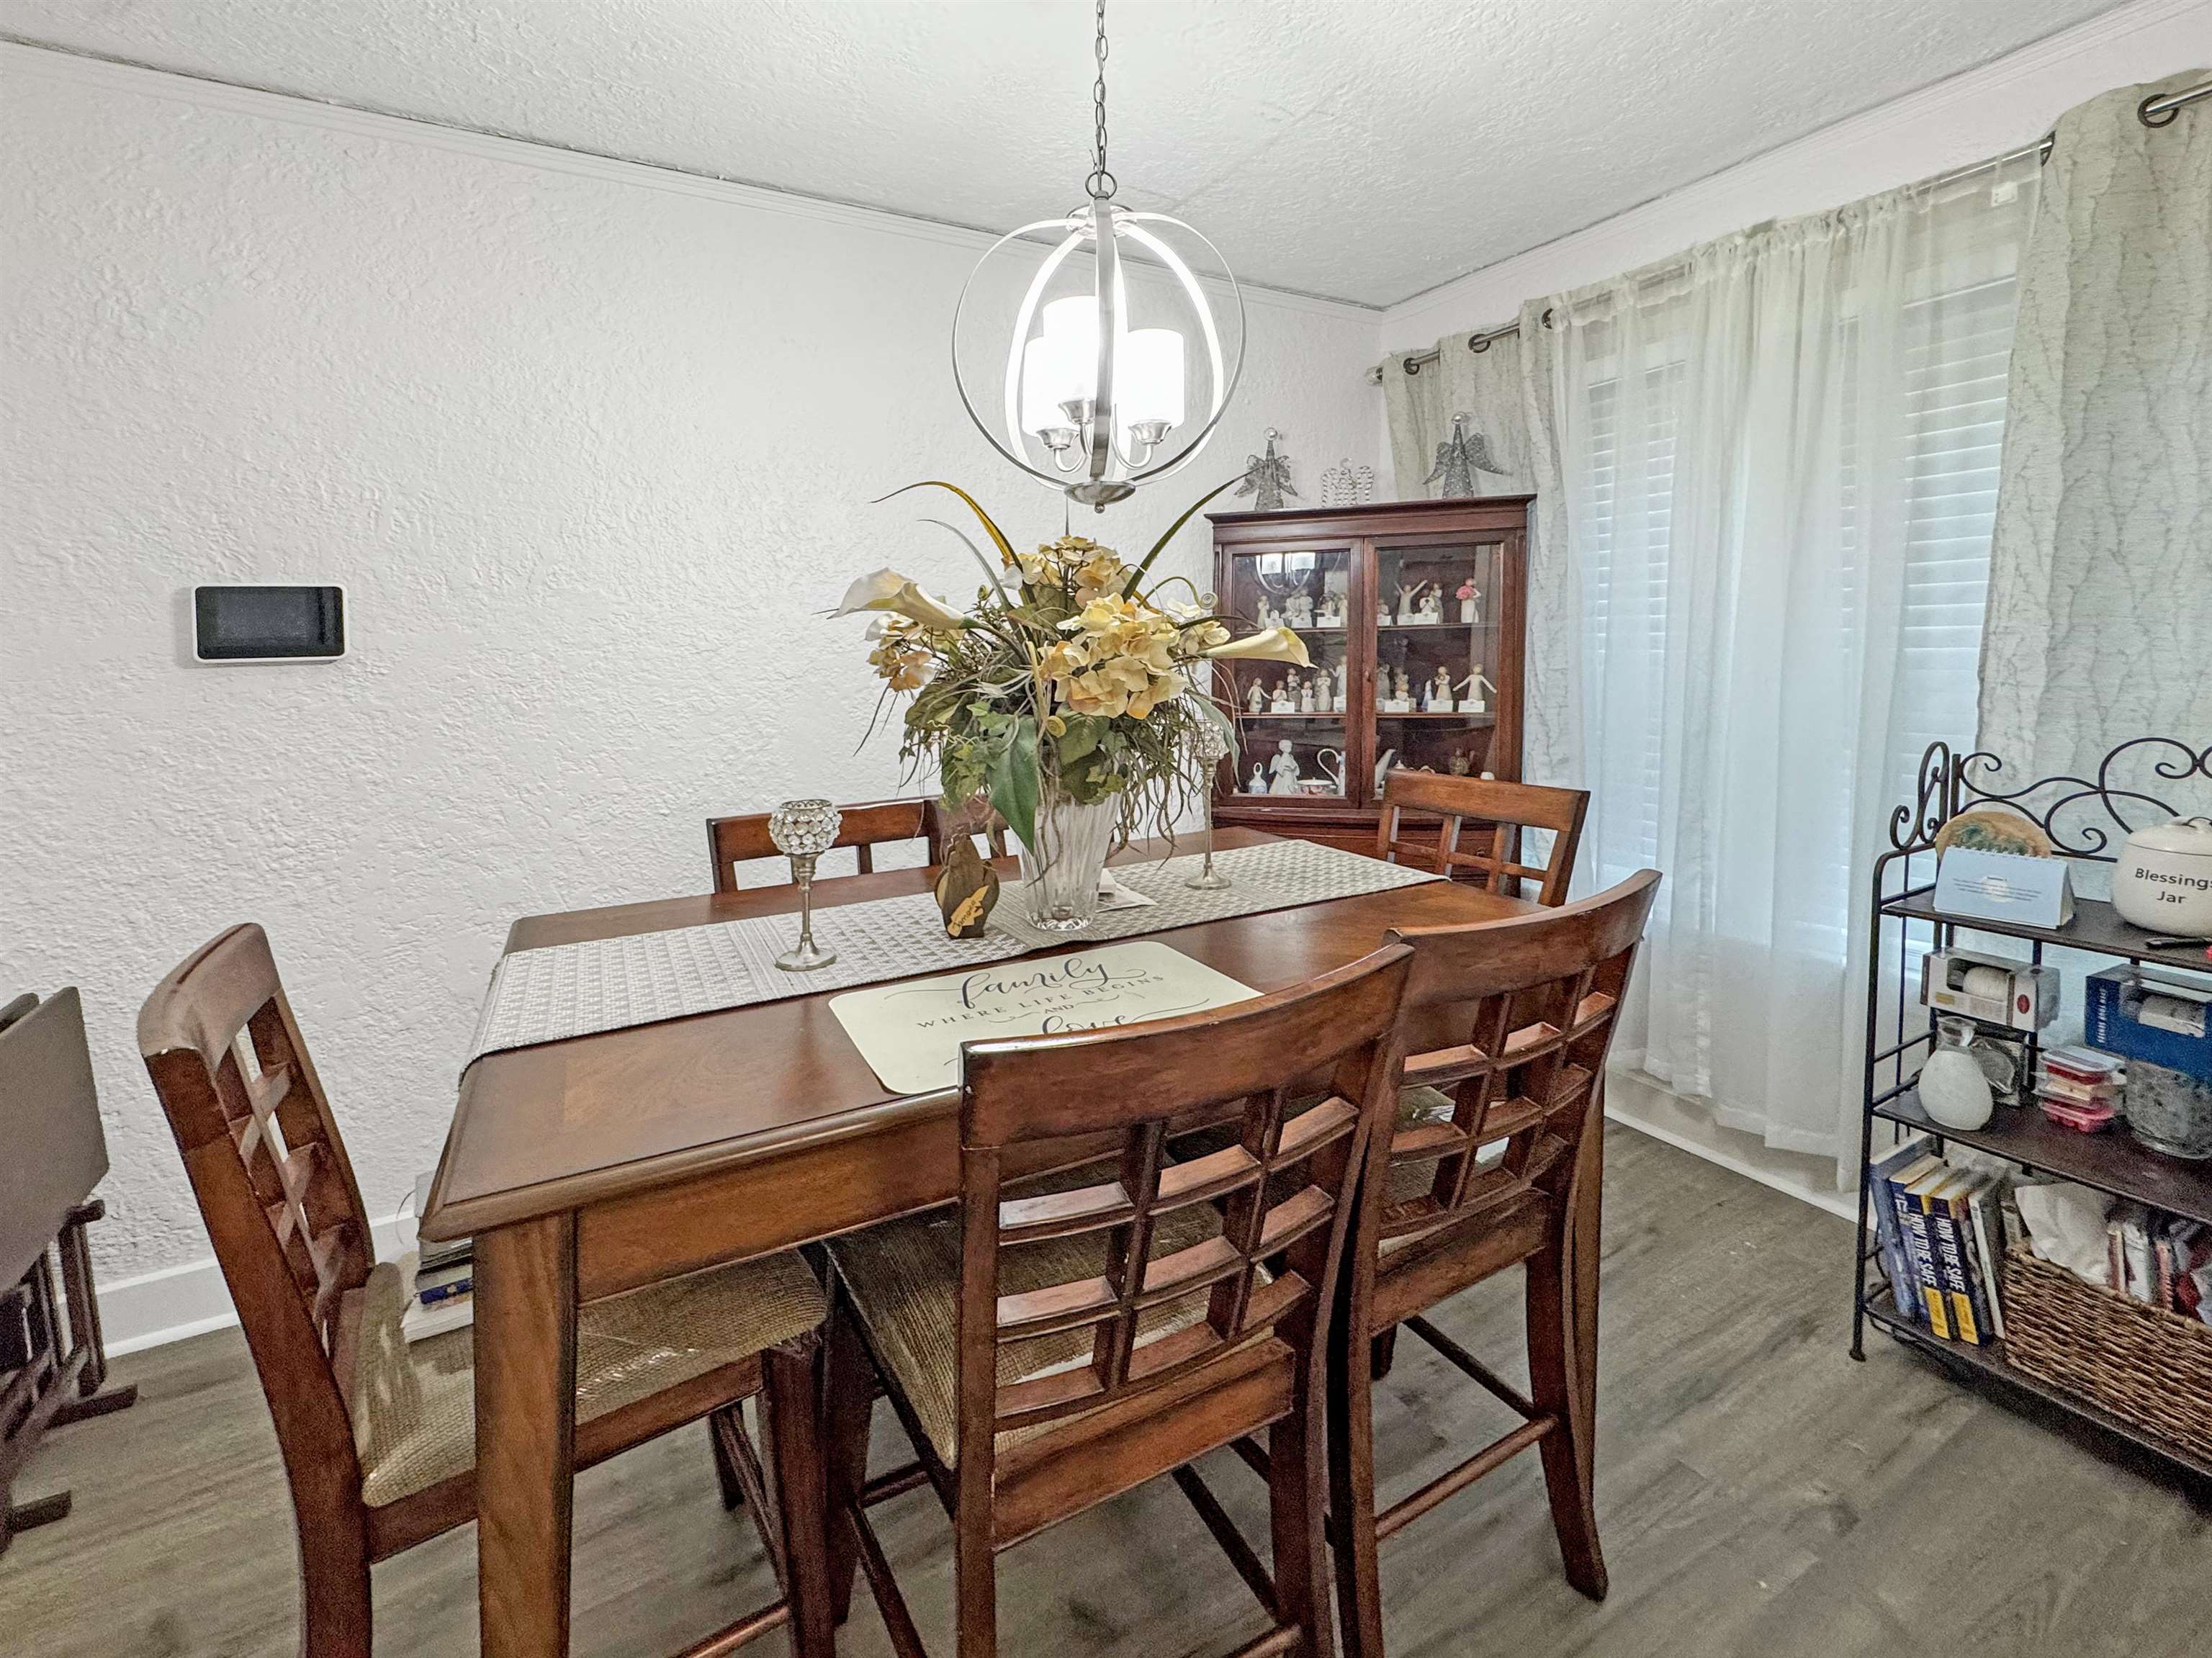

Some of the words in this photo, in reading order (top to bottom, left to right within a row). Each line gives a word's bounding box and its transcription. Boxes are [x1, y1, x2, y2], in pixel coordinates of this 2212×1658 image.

[2134, 868, 2212, 891] Blessing
[2156, 891, 2187, 904] Jar
[956, 957, 1146, 1009] family
[917, 1006, 1007, 1028] WHERE
[1019, 993, 1072, 1009] LIFE
[1081, 975, 1164, 996] BEGINS
[1043, 1004, 1074, 1014] AND
[1909, 1213, 1928, 1238] HOW
[1935, 1217, 1957, 1244] HOW
[1914, 1238, 1930, 1250] TO
[1941, 1242, 1958, 1255] TO
[1916, 1249, 1933, 1263] BE
[1943, 1253, 1960, 1268] BE
[1918, 1261, 1937, 1288] SAFE
[1946, 1266, 1966, 1292] SAFE
